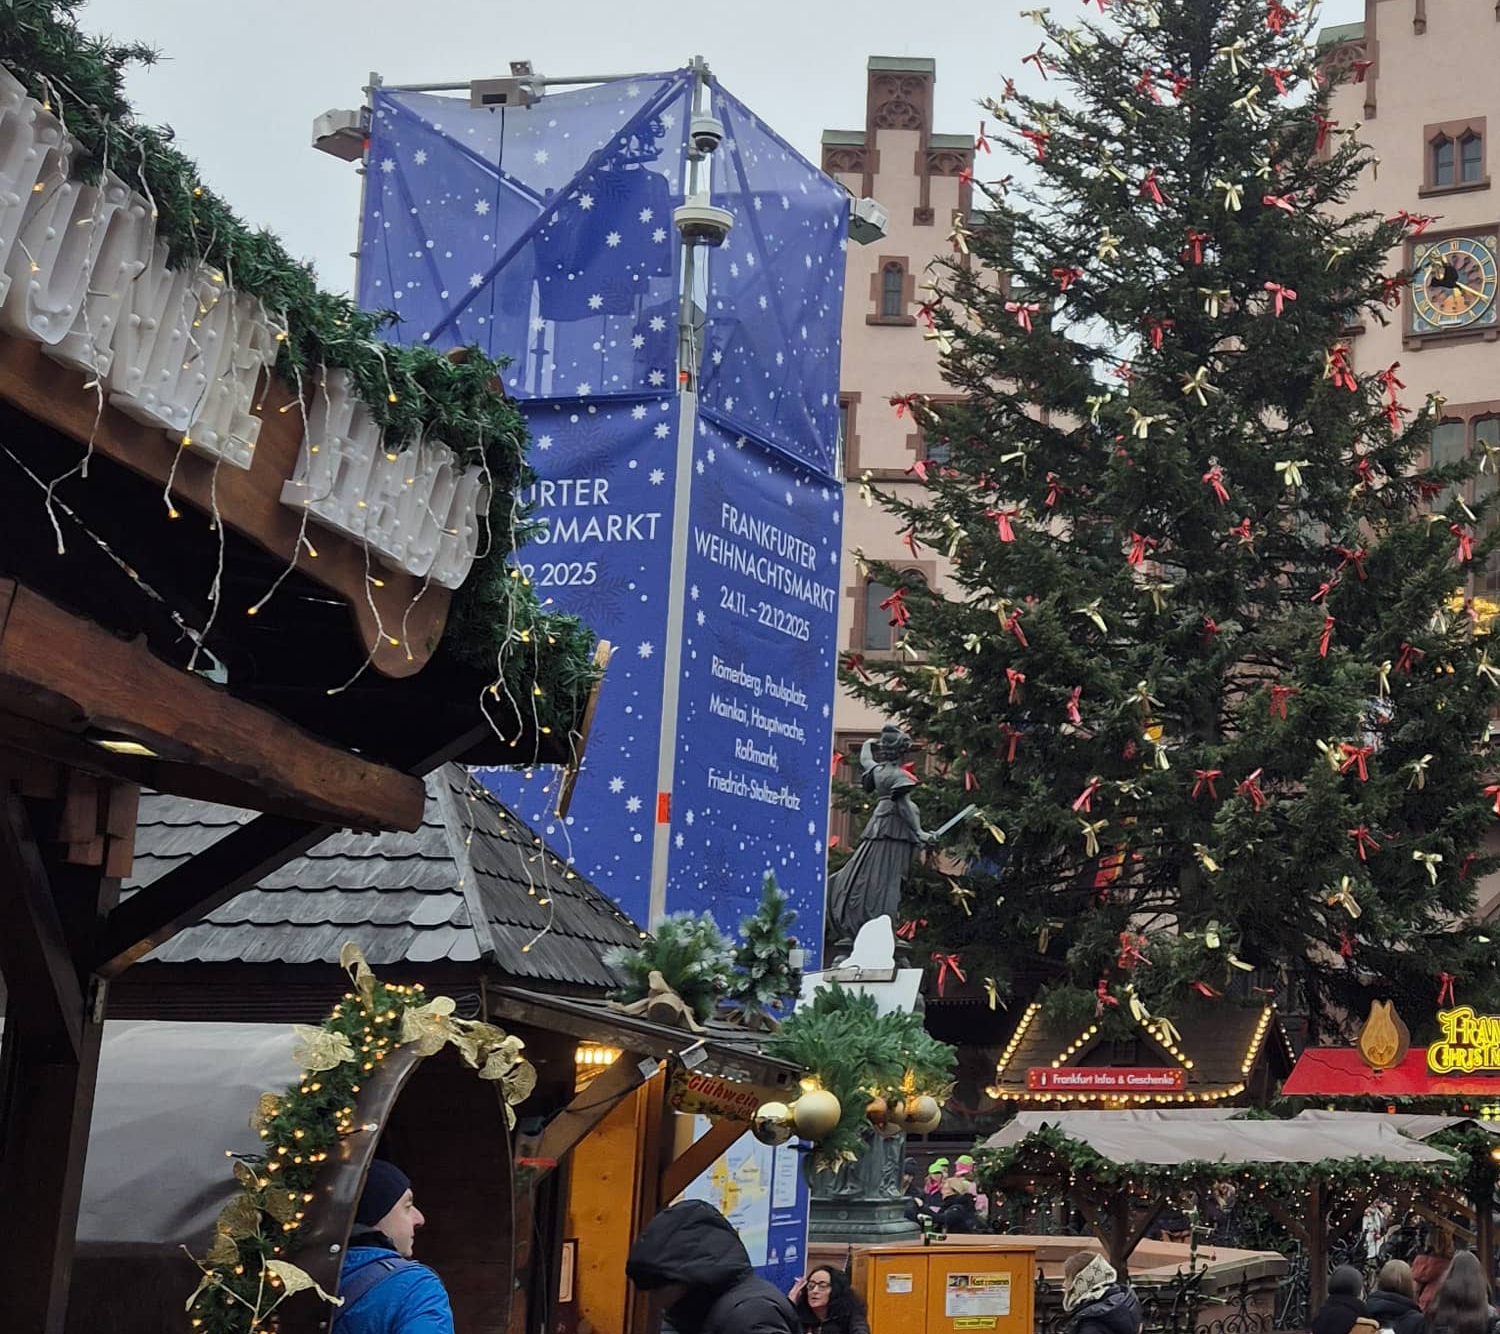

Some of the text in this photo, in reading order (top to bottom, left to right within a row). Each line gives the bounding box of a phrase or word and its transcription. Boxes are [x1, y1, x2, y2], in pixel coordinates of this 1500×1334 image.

[720, 501, 817, 572] FRANKFURTER
[694, 525, 837, 615] WEIHNACHTSMARKT
[711, 654, 809, 711] Römerberg, Paulsplatz,
[709, 692, 807, 746] Mainkai, Hauptwache,
[687, 1074, 760, 1109] Glühwein
[1052, 1073, 1175, 1086] Frankfurt Infos & Geschenke
